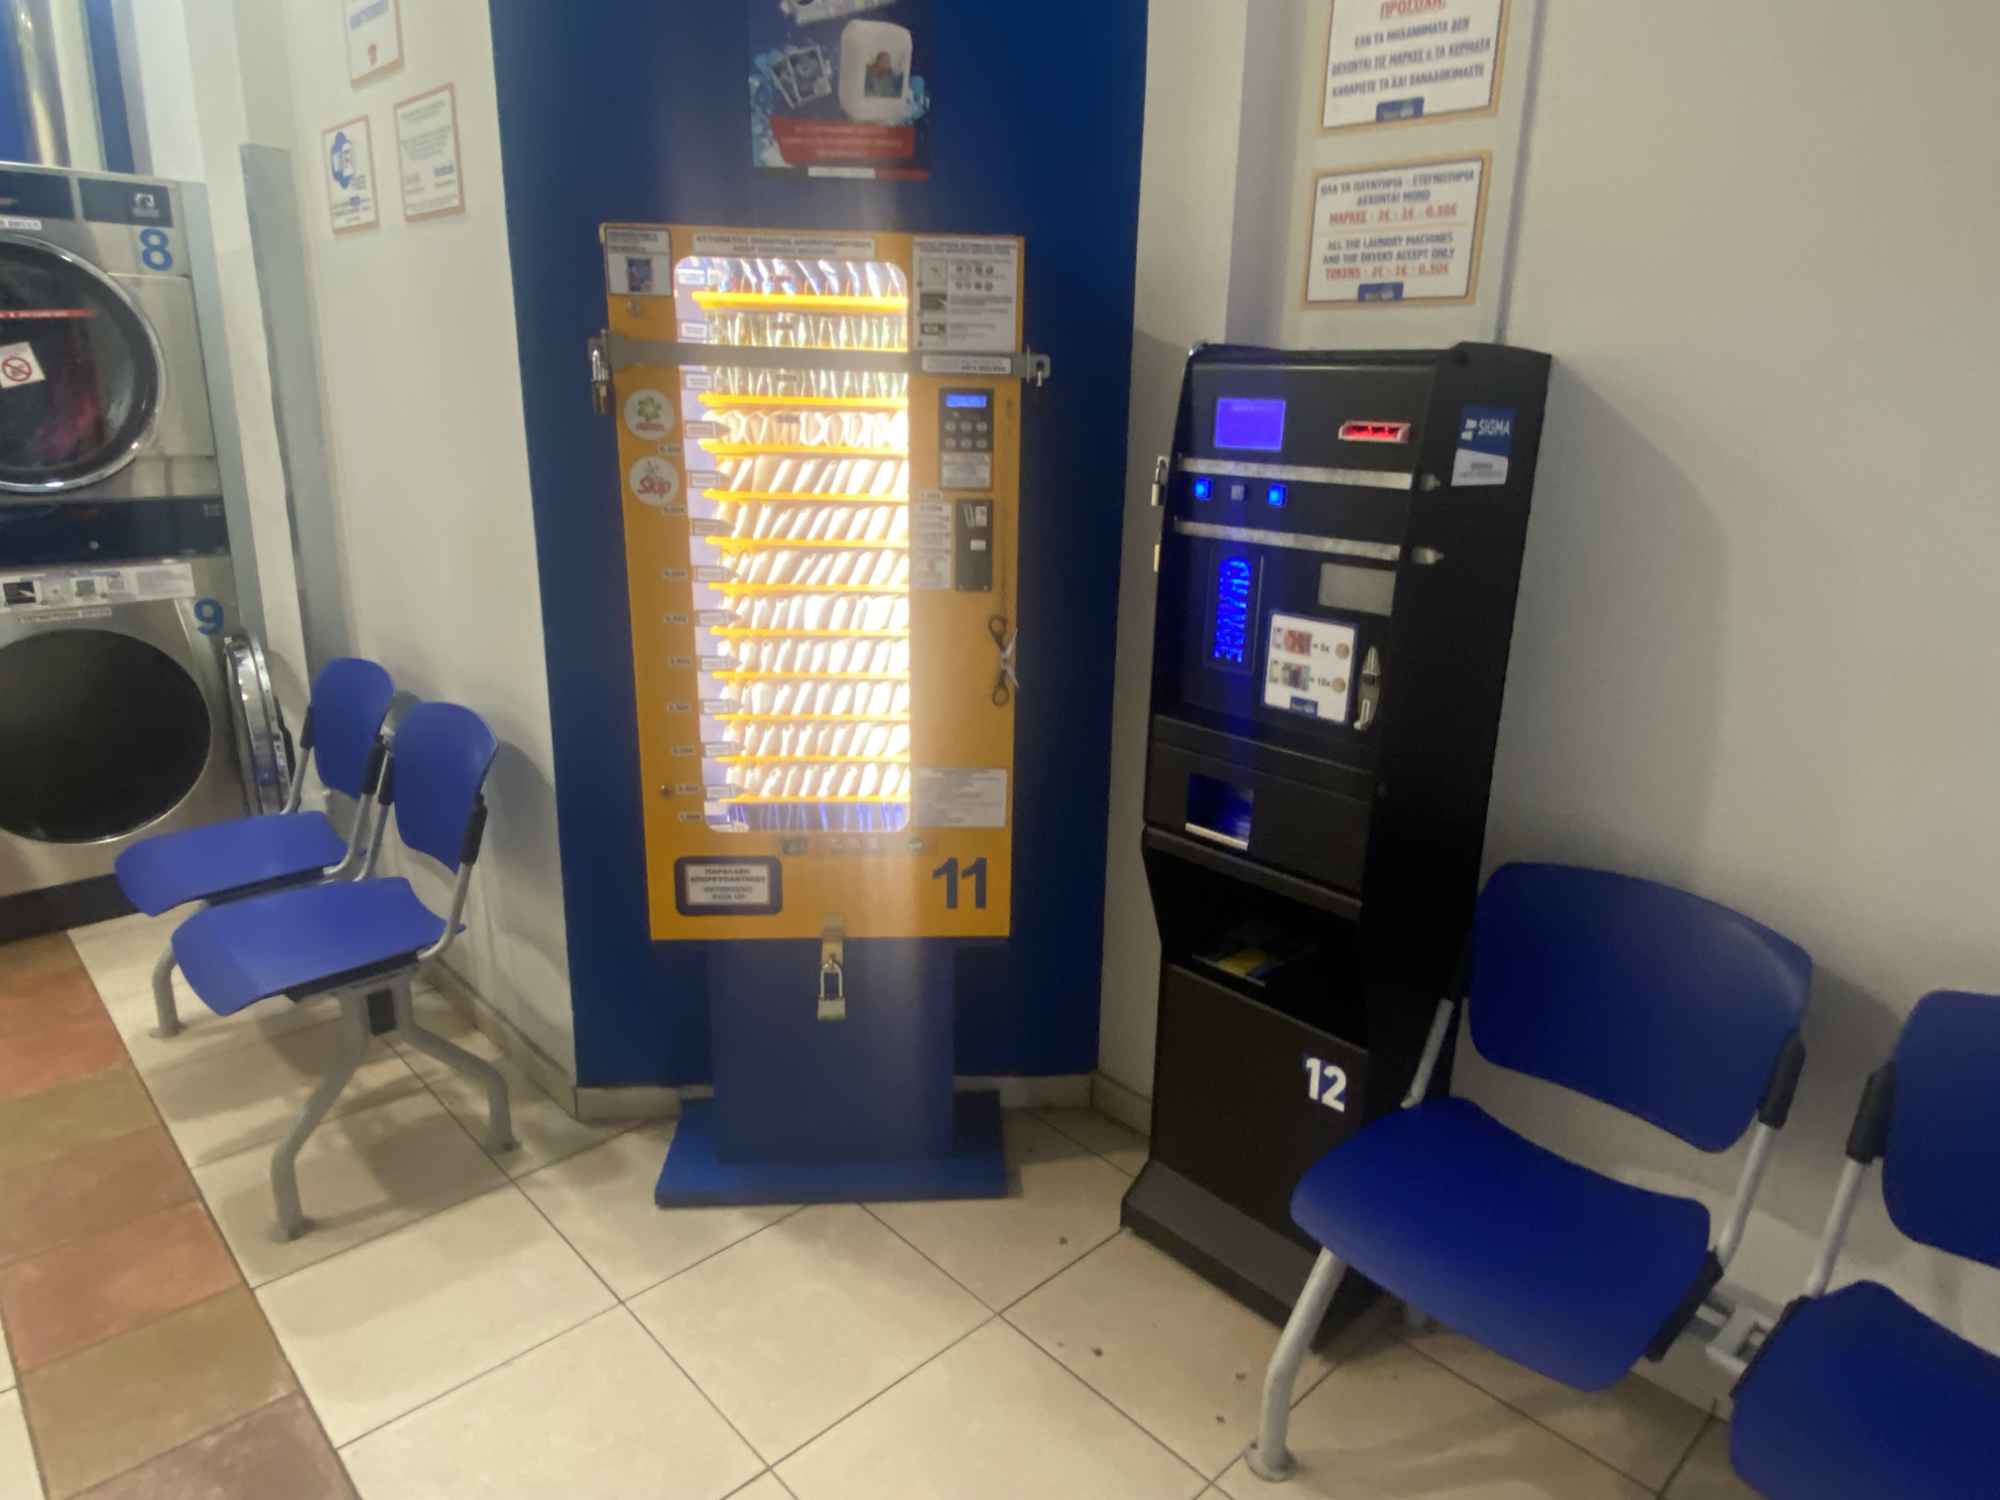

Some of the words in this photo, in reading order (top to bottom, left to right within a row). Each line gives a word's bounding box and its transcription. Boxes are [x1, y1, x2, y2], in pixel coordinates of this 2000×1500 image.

[139, 227, 173, 272] 8
[638, 474, 672, 498] Skip
[193, 597, 225, 636] 9
[932, 856, 988, 910] 11
[1306, 1057, 1347, 1112] 12
